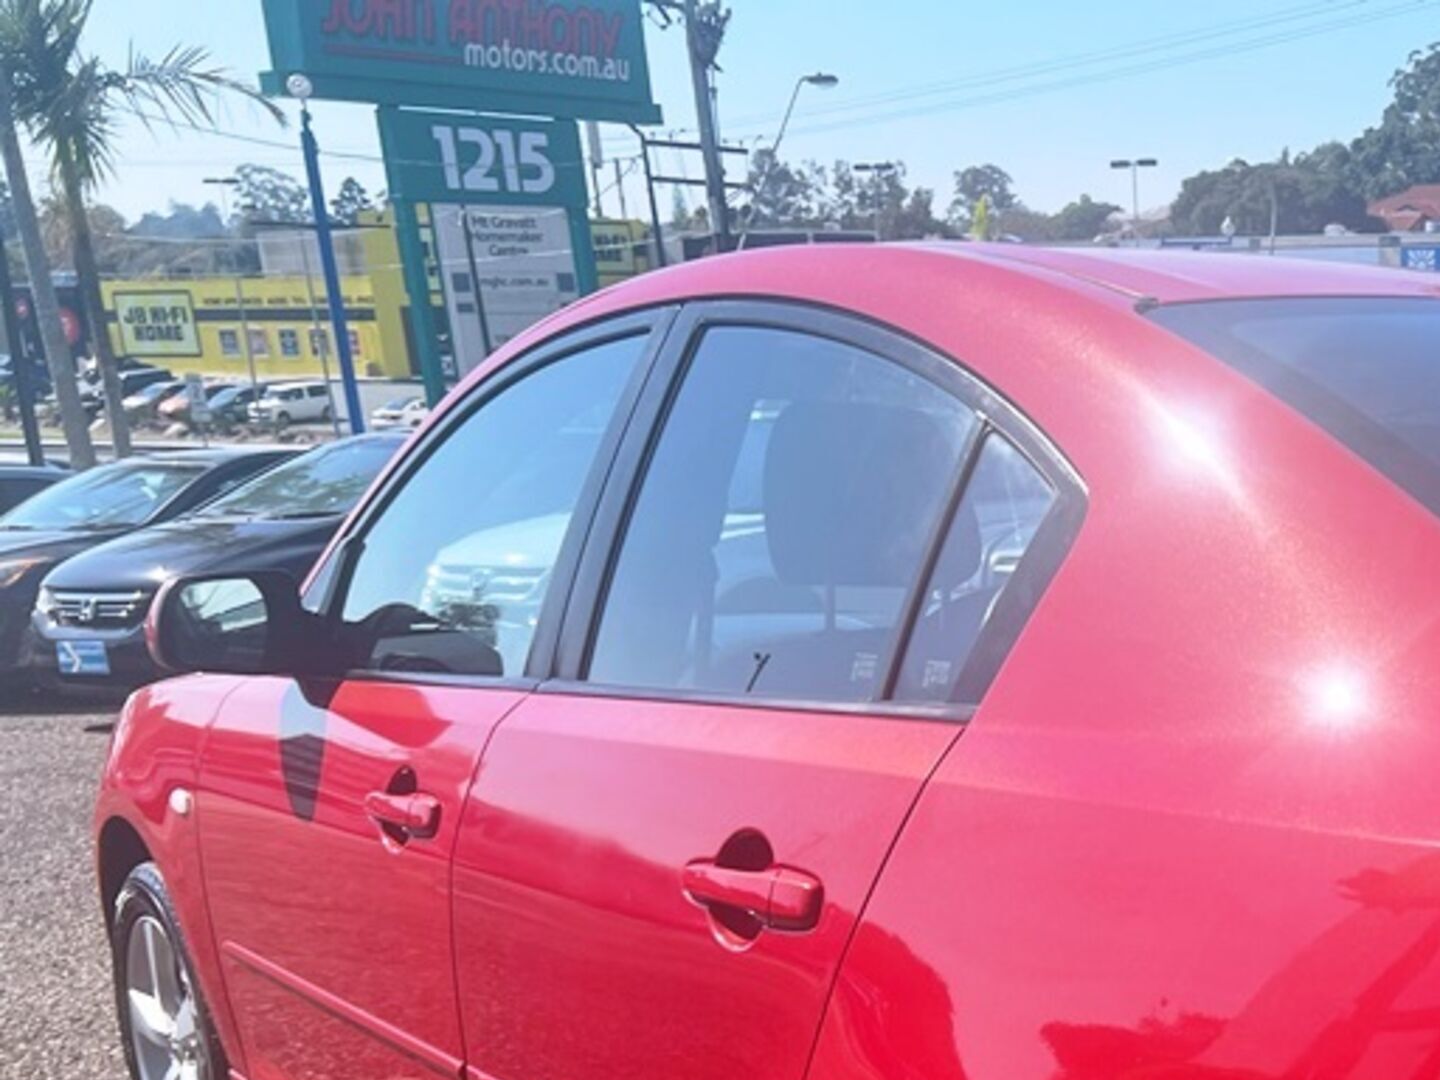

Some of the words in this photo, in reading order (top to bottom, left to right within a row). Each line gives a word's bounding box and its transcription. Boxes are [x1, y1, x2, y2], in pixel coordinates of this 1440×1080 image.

[464, 38, 630, 82] motors.com.au
[431, 125, 555, 193] 1215
[123, 306, 147, 324] JB
